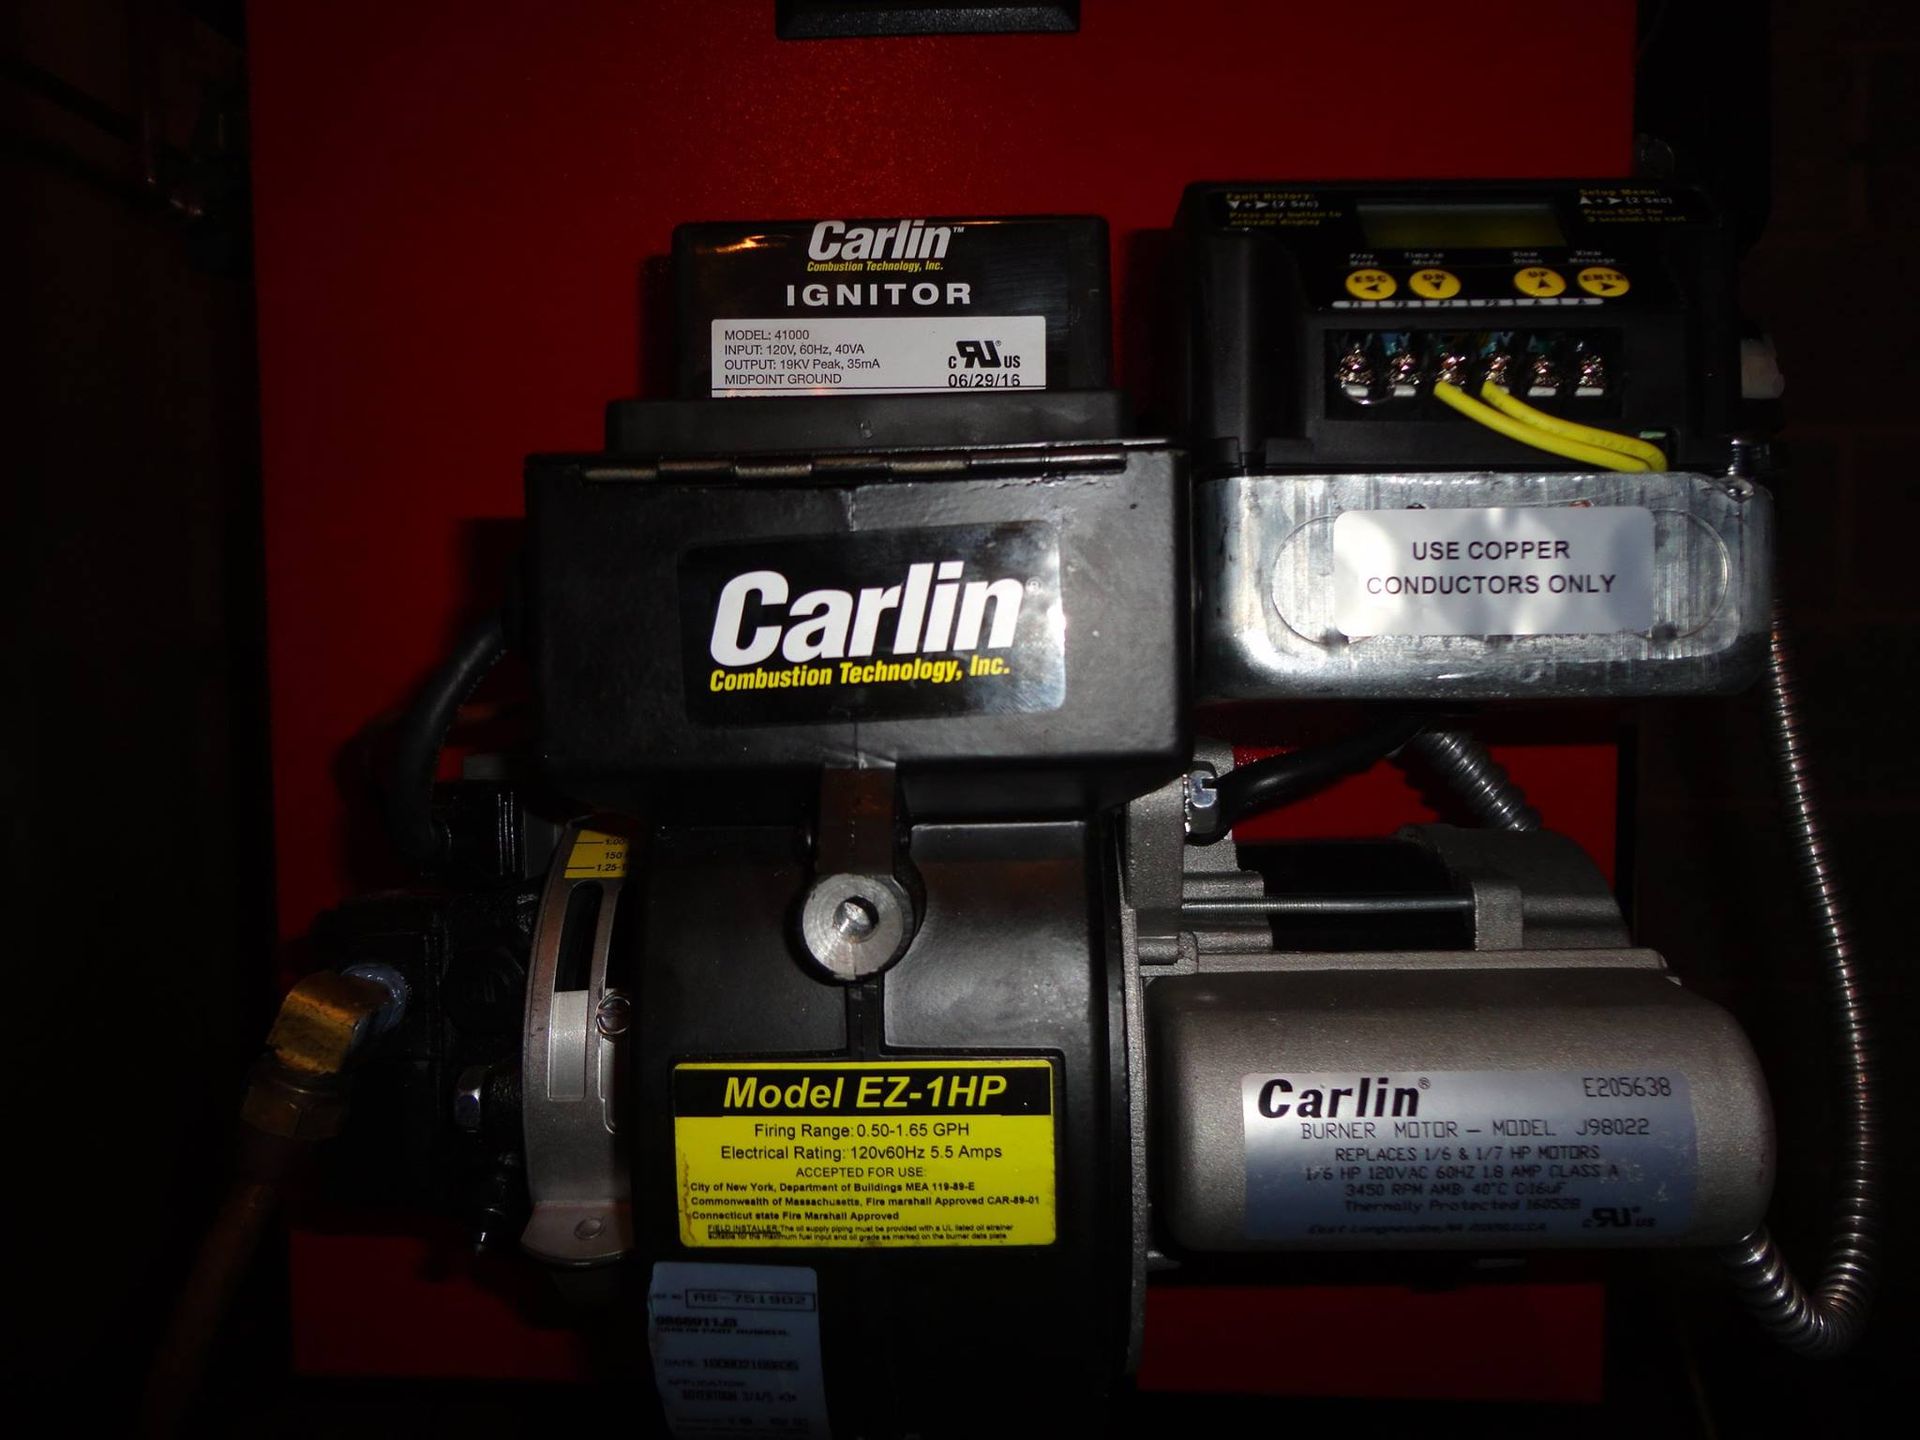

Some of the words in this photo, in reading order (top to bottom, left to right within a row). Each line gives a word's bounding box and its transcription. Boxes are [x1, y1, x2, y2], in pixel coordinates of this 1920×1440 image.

[807, 261, 862, 271] Combustion
[867, 261, 922, 272] Technology,
[925, 261, 943, 270] Inc.
[787, 283, 971, 307] IGNITOR
[724, 330, 771, 340] MODEL:
[775, 330, 809, 340] 41000
[725, 345, 762, 355] INPUT:
[768, 345, 797, 356] 120V,
[800, 344, 831, 355] 60Hz,
[835, 344, 864, 354] 40VA
[724, 360, 776, 370] OUTPUT:
[781, 359, 809, 369] 19KV
[813, 359, 843, 369] Peak,
[847, 358, 880, 369] 35mA
[725, 374, 784, 385] MIDPOINT
[788, 374, 841, 384] GROUND
[948, 374, 1020, 387] 06/29/16
[1413, 542, 1459, 560] USE
[1468, 541, 1570, 560] COPPER
[1367, 576, 1539, 594] CONDUCTORS
[1549, 574, 1616, 593] ONLY
[710, 665, 831, 692] Combustion
[840, 657, 962, 684] Technology,
[970, 654, 1010, 676] Inc.
[724, 1076, 844, 1109] Model
[856, 1075, 1007, 1108] EZ-1HP
[1582, 1077, 1672, 1097] E205638
[754, 1124, 796, 1140] Firing
[802, 1124, 854, 1139] Range:
[857, 1124, 928, 1137] 0.50-1.65
[933, 1123, 970, 1136] GPH
[1301, 1122, 1376, 1139] BURNER
[1394, 1121, 1458, 1138] MOTOR
[1493, 1119, 1556, 1136] MODEL
[1576, 1118, 1649, 1136] J98022
[721, 1146, 788, 1160] Electrical
[795, 1146, 845, 1161] Rating:
[851, 1146, 924, 1159] 120v60Hz
[931, 1146, 952, 1158] 5.5
[959, 1145, 1002, 1161] Amps
[1336, 1148, 1417, 1161] REPLACES
[1425, 1148, 1451, 1161] 1/6
[1459, 1149, 1468, 1160] &
[1477, 1147, 1503, 1160] 1/7
[1511, 1147, 1531, 1159] HP
[1538, 1145, 1600, 1159] MOTORS
[796, 1168, 864, 1177] ACCEPTED
[868, 1167, 894, 1177] FOR
[1306, 1167, 1333, 1181] 1/6
[1340, 1167, 1360, 1180] HP
[1369, 1166, 1427, 1179] 120VAC
[1436, 1166, 1476, 1179] 60HZ
[1511, 1165, 1541, 1178] AMP
[1549, 1165, 1600, 1178] CLASS
[1608, 1165, 1619, 1176] A
[691, 1183, 710, 1192] City
[713, 1183, 723, 1191] of
[727, 1183, 747, 1191] New
[751, 1183, 776, 1192] York,
[780, 1183, 837, 1193] Department
[841, 1183, 851, 1191] of
[855, 1183, 902, 1193] Buildings
[906, 1183, 928, 1191] MEA
[933, 1182, 975, 1190] 119-89-E
[1346, 1184, 1384, 1197] 3450
[1392, 1184, 1422, 1195] RPM
[691, 1197, 768, 1205] Commonwealth
[772, 1197, 782, 1205] of
[785, 1197, 863, 1207] Massachusetts,
[889, 1197, 932, 1205] marshall
[935, 1197, 983, 1207] Approved
[987, 1196, 1040, 1204] CAR-89-01
[1346, 1200, 1423, 1214] Thermally
[1431, 1200, 1519, 1211] Protected
[692, 1211, 751, 1220] Connecticut
[756, 1212, 779, 1220] state
[783, 1212, 801, 1220] Fire
[805, 1211, 847, 1220] Marshall
[851, 1211, 899, 1221] Approved
